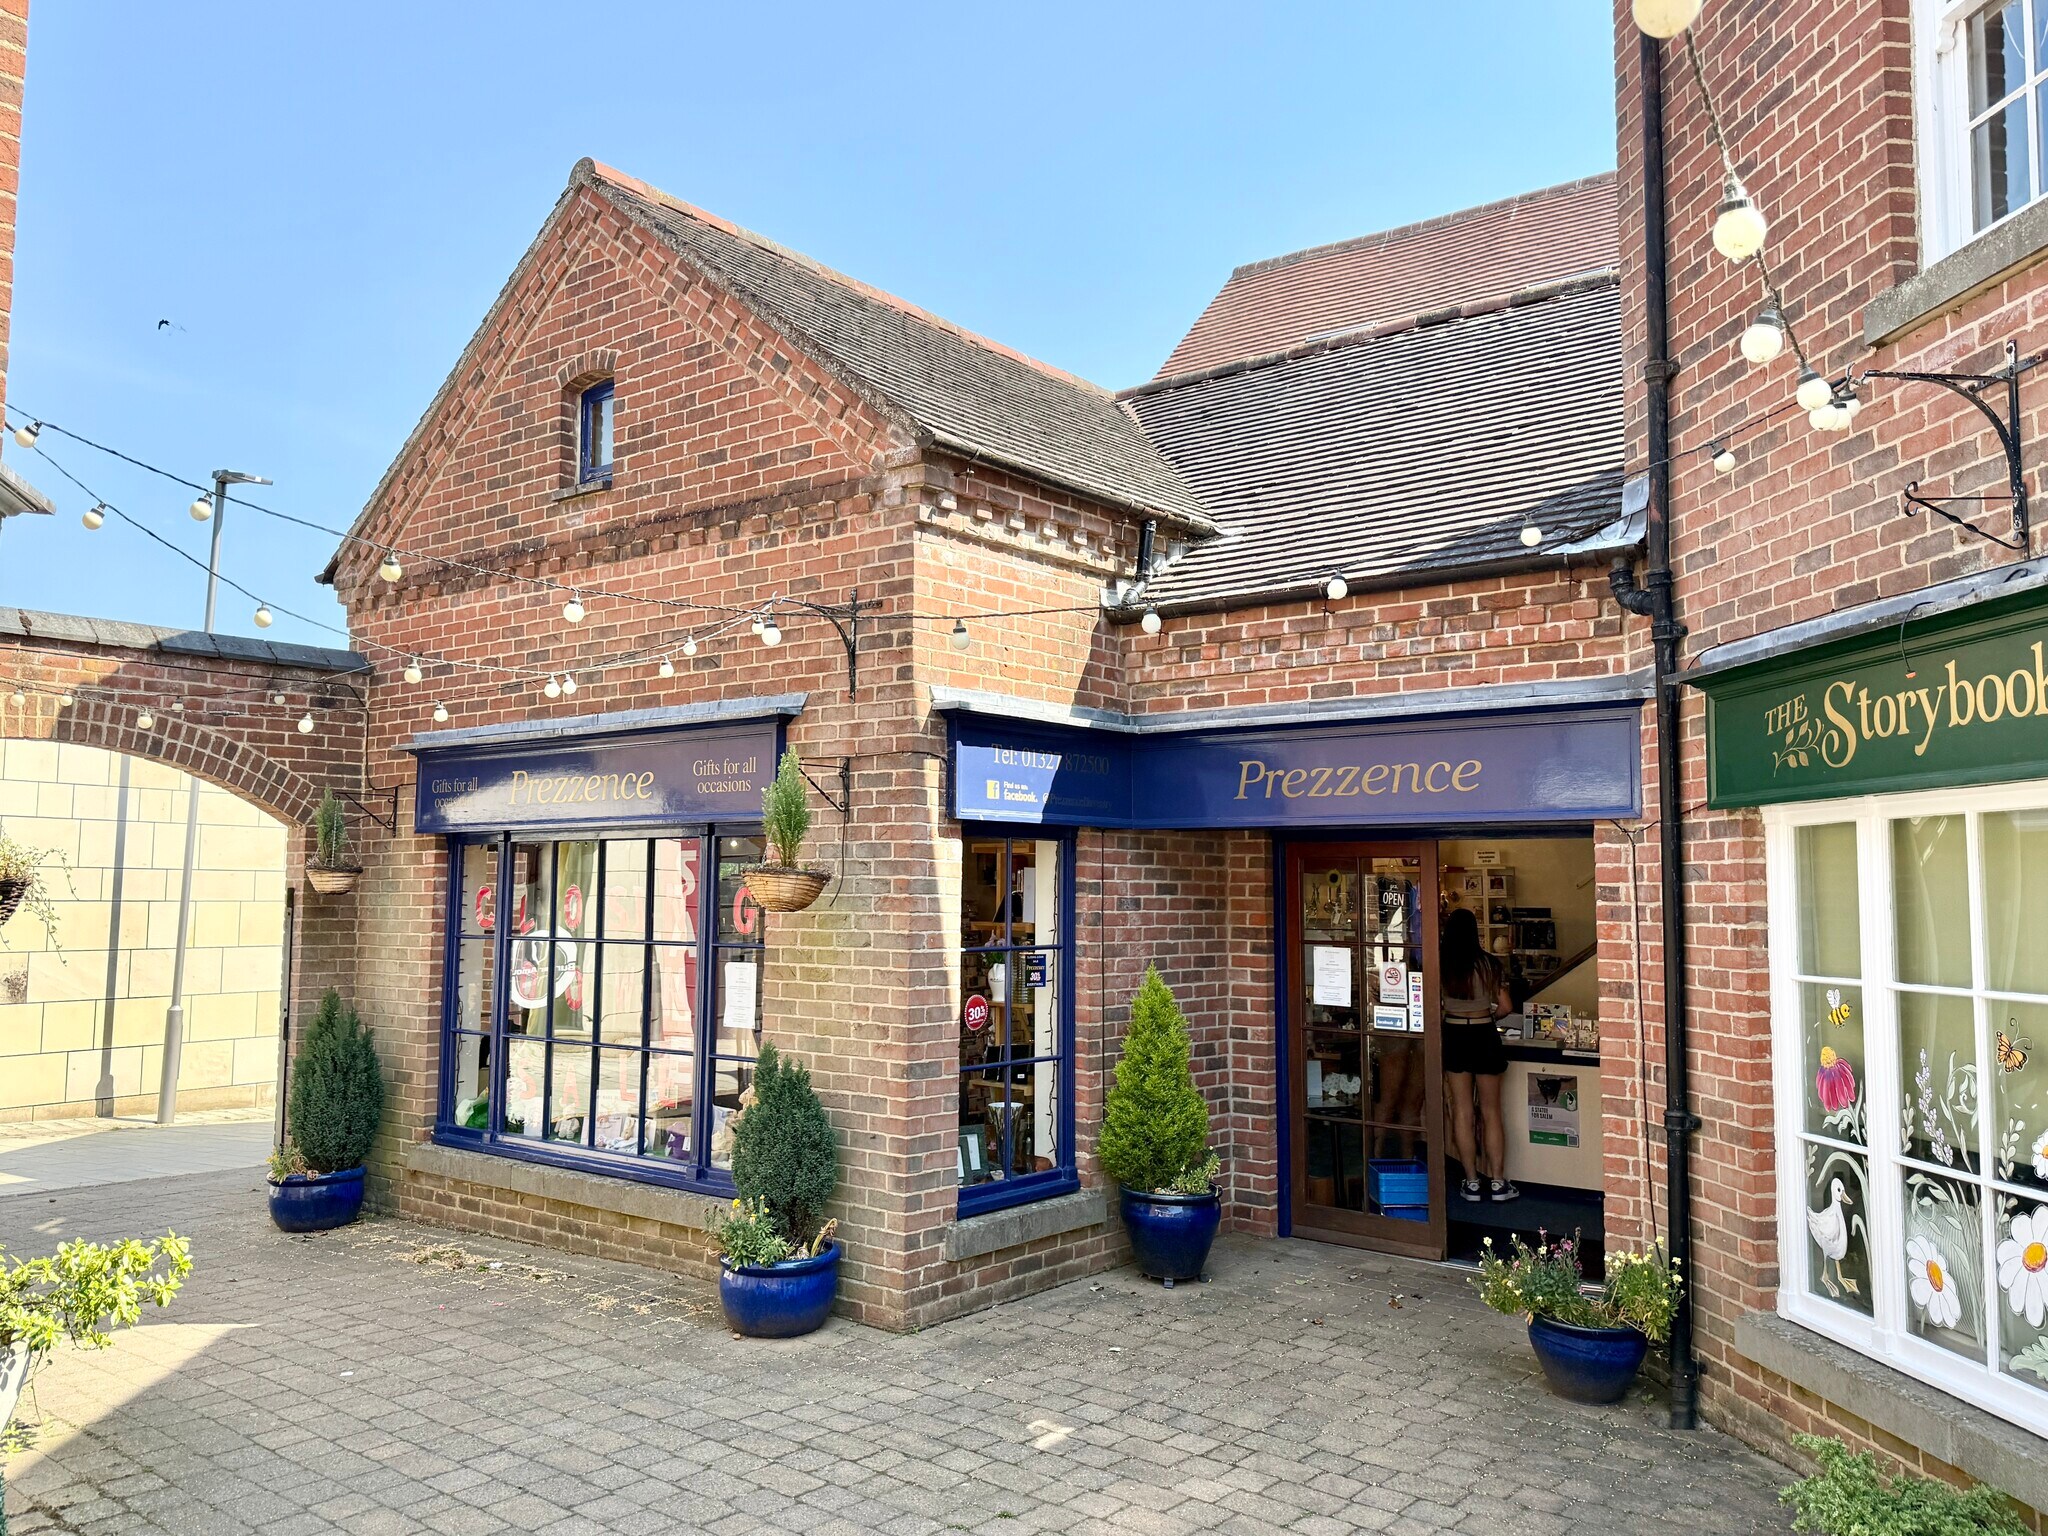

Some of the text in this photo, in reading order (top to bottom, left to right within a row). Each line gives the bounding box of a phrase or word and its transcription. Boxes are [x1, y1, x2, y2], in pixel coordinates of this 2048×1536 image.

[1764, 693, 1806, 736] THE
[692, 756, 757, 776] Gifts for all
[991, 743, 1110, 775] Tel: 01327 872500
[431, 776, 478, 794] Gifts for all
[508, 770, 655, 805] Prezzence
[697, 776, 752, 794] occasions
[1233, 759, 1483, 800] Prezzence
[434, 793, 471, 809] occasi
[1382, 892, 1405, 906] OPEN
